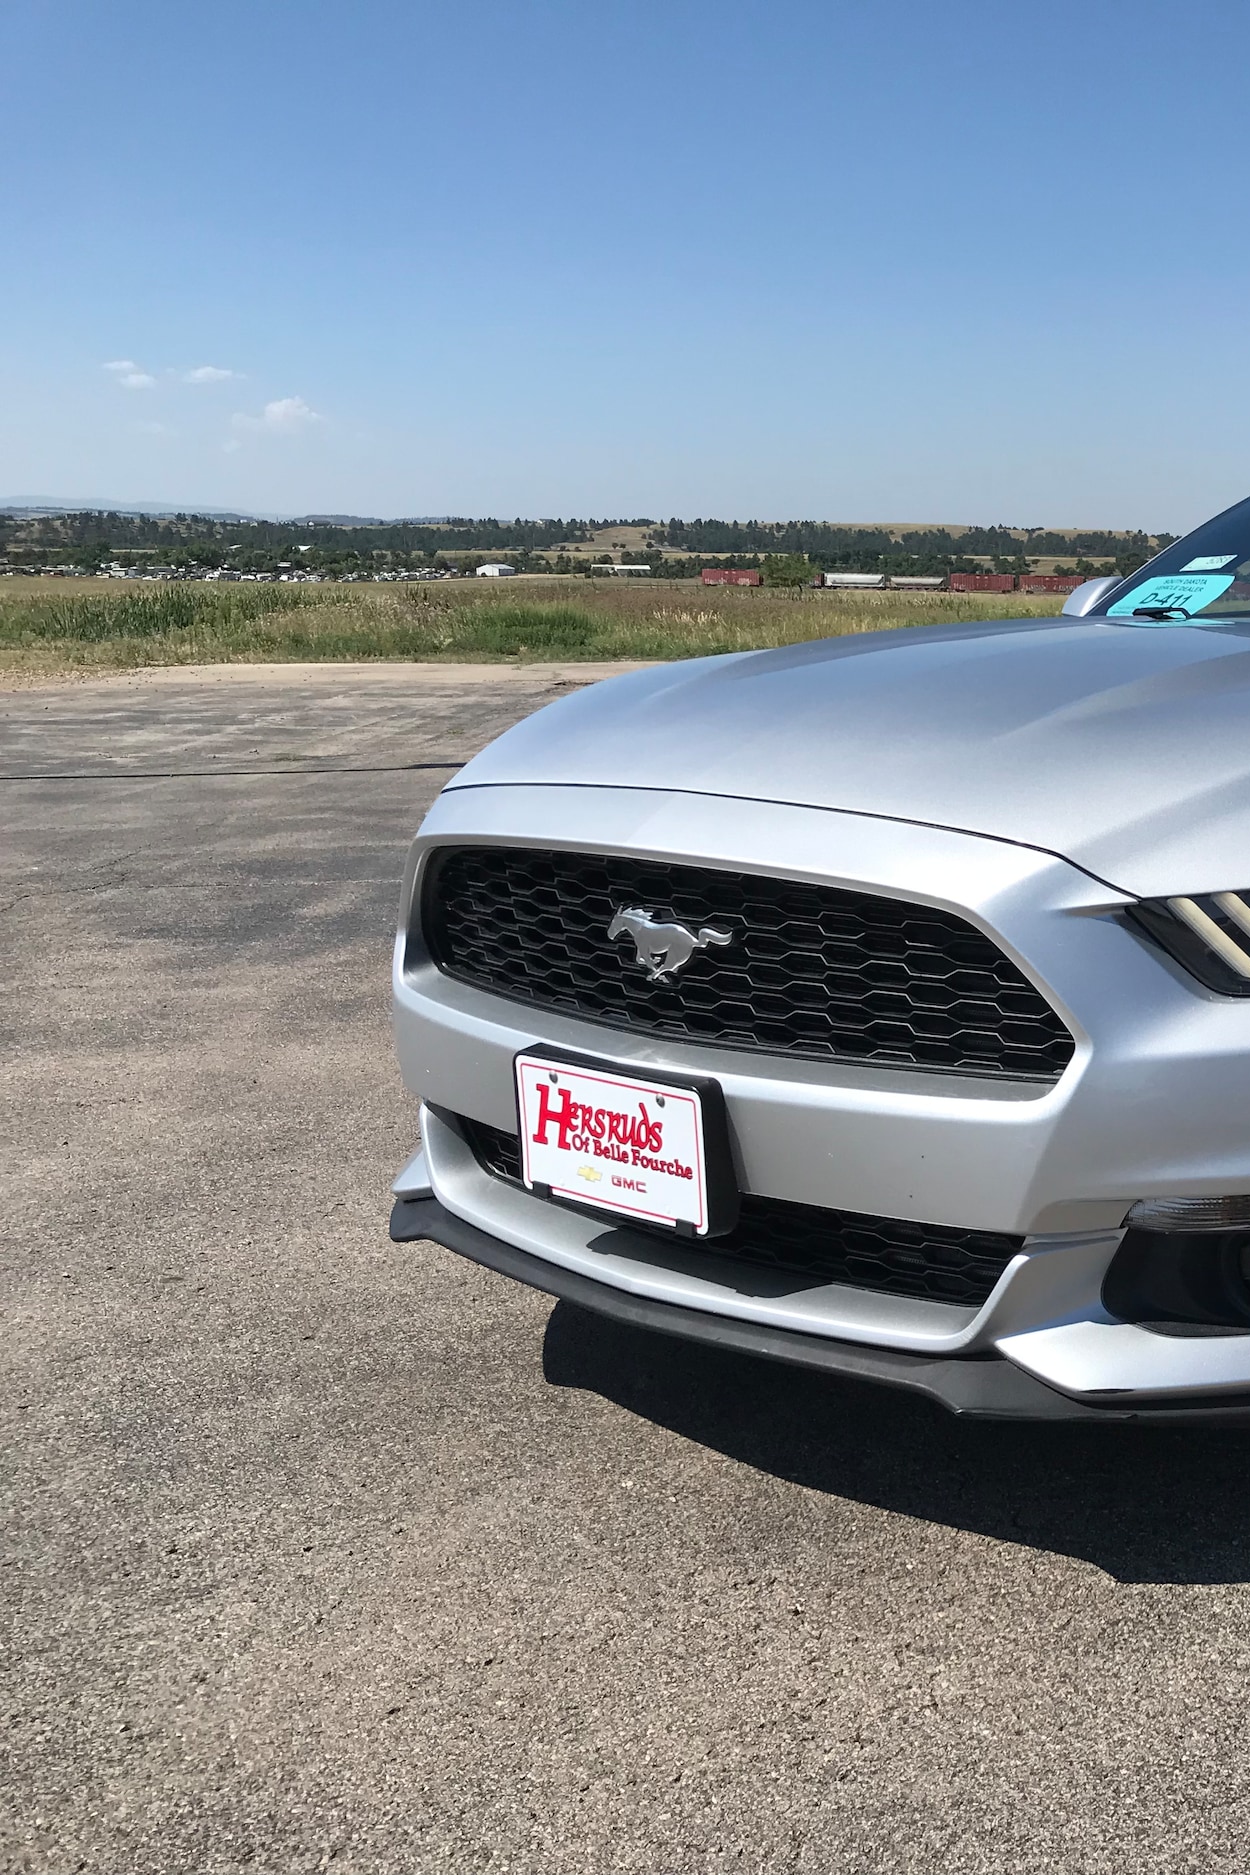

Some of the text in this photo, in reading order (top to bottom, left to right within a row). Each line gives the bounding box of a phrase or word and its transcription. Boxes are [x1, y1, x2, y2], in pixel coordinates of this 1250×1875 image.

[1139, 593, 1193, 607] D-411
[572, 1134, 693, 1180] Of Belle Fourche
[611, 1174, 647, 1194] GMC
